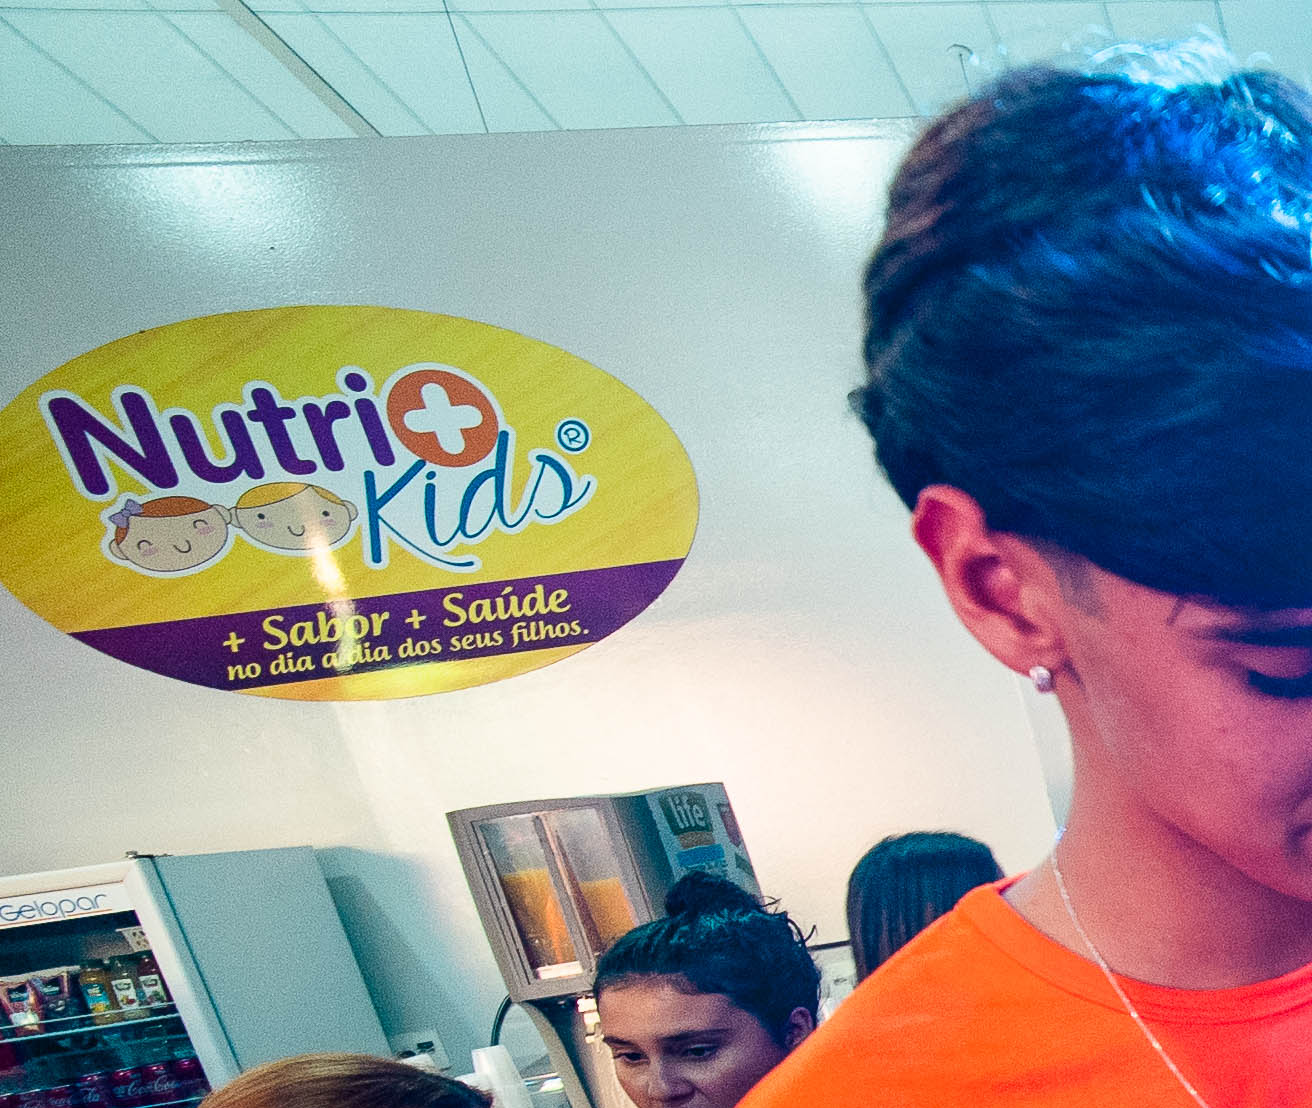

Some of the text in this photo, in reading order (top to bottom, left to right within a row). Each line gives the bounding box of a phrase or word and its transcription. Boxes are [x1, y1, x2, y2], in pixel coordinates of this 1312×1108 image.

[364, 430, 591, 566] Kids
[228, 618, 589, 681] no dia a dia dos seus filhos.
[262, 611, 390, 651] Sabor
[443, 585, 571, 628] Saúde
[668, 795, 706, 829] life
[0, 893, 107, 923] Gelopar
